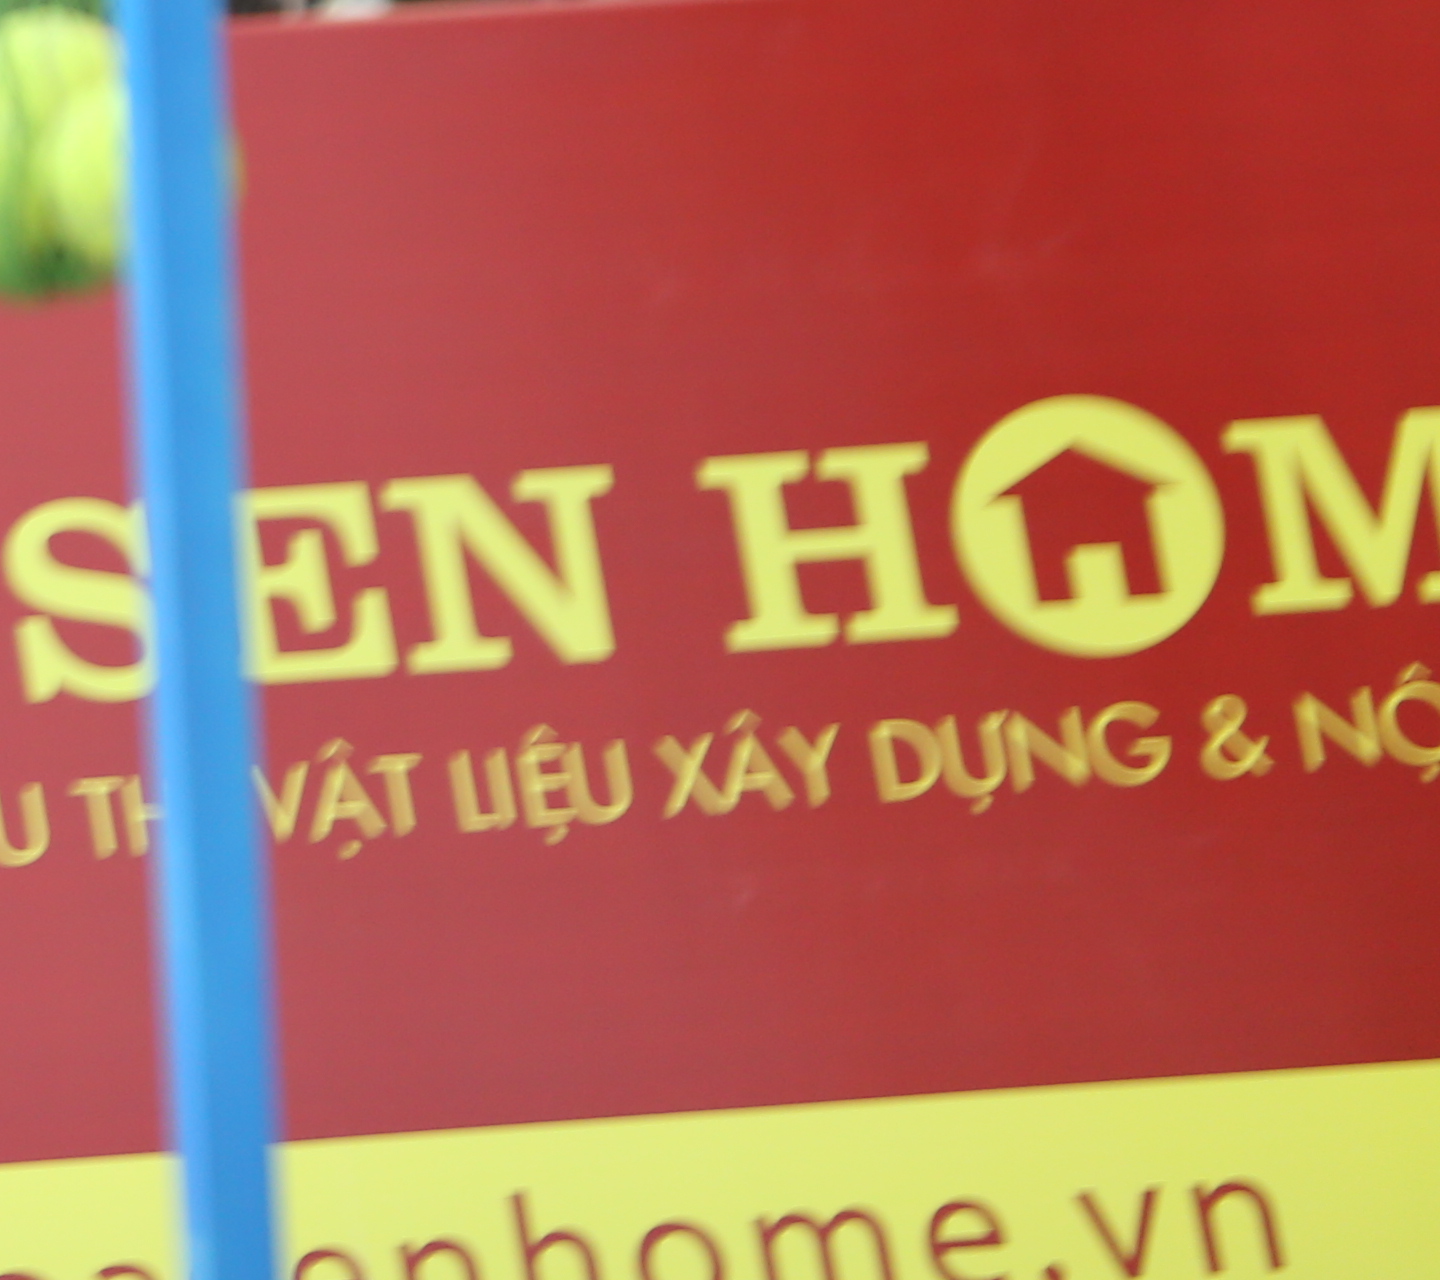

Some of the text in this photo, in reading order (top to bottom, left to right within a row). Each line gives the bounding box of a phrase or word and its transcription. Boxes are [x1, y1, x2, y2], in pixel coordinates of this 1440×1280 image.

[2, 462, 616, 704] SEN
[68, 773, 168, 861] TH
[251, 738, 422, 861] VẬT
[448, 724, 634, 845] LIỆU
[655, 708, 841, 820] XÂY
[868, 700, 1174, 814] DỰNG
[1199, 693, 1274, 781] &
